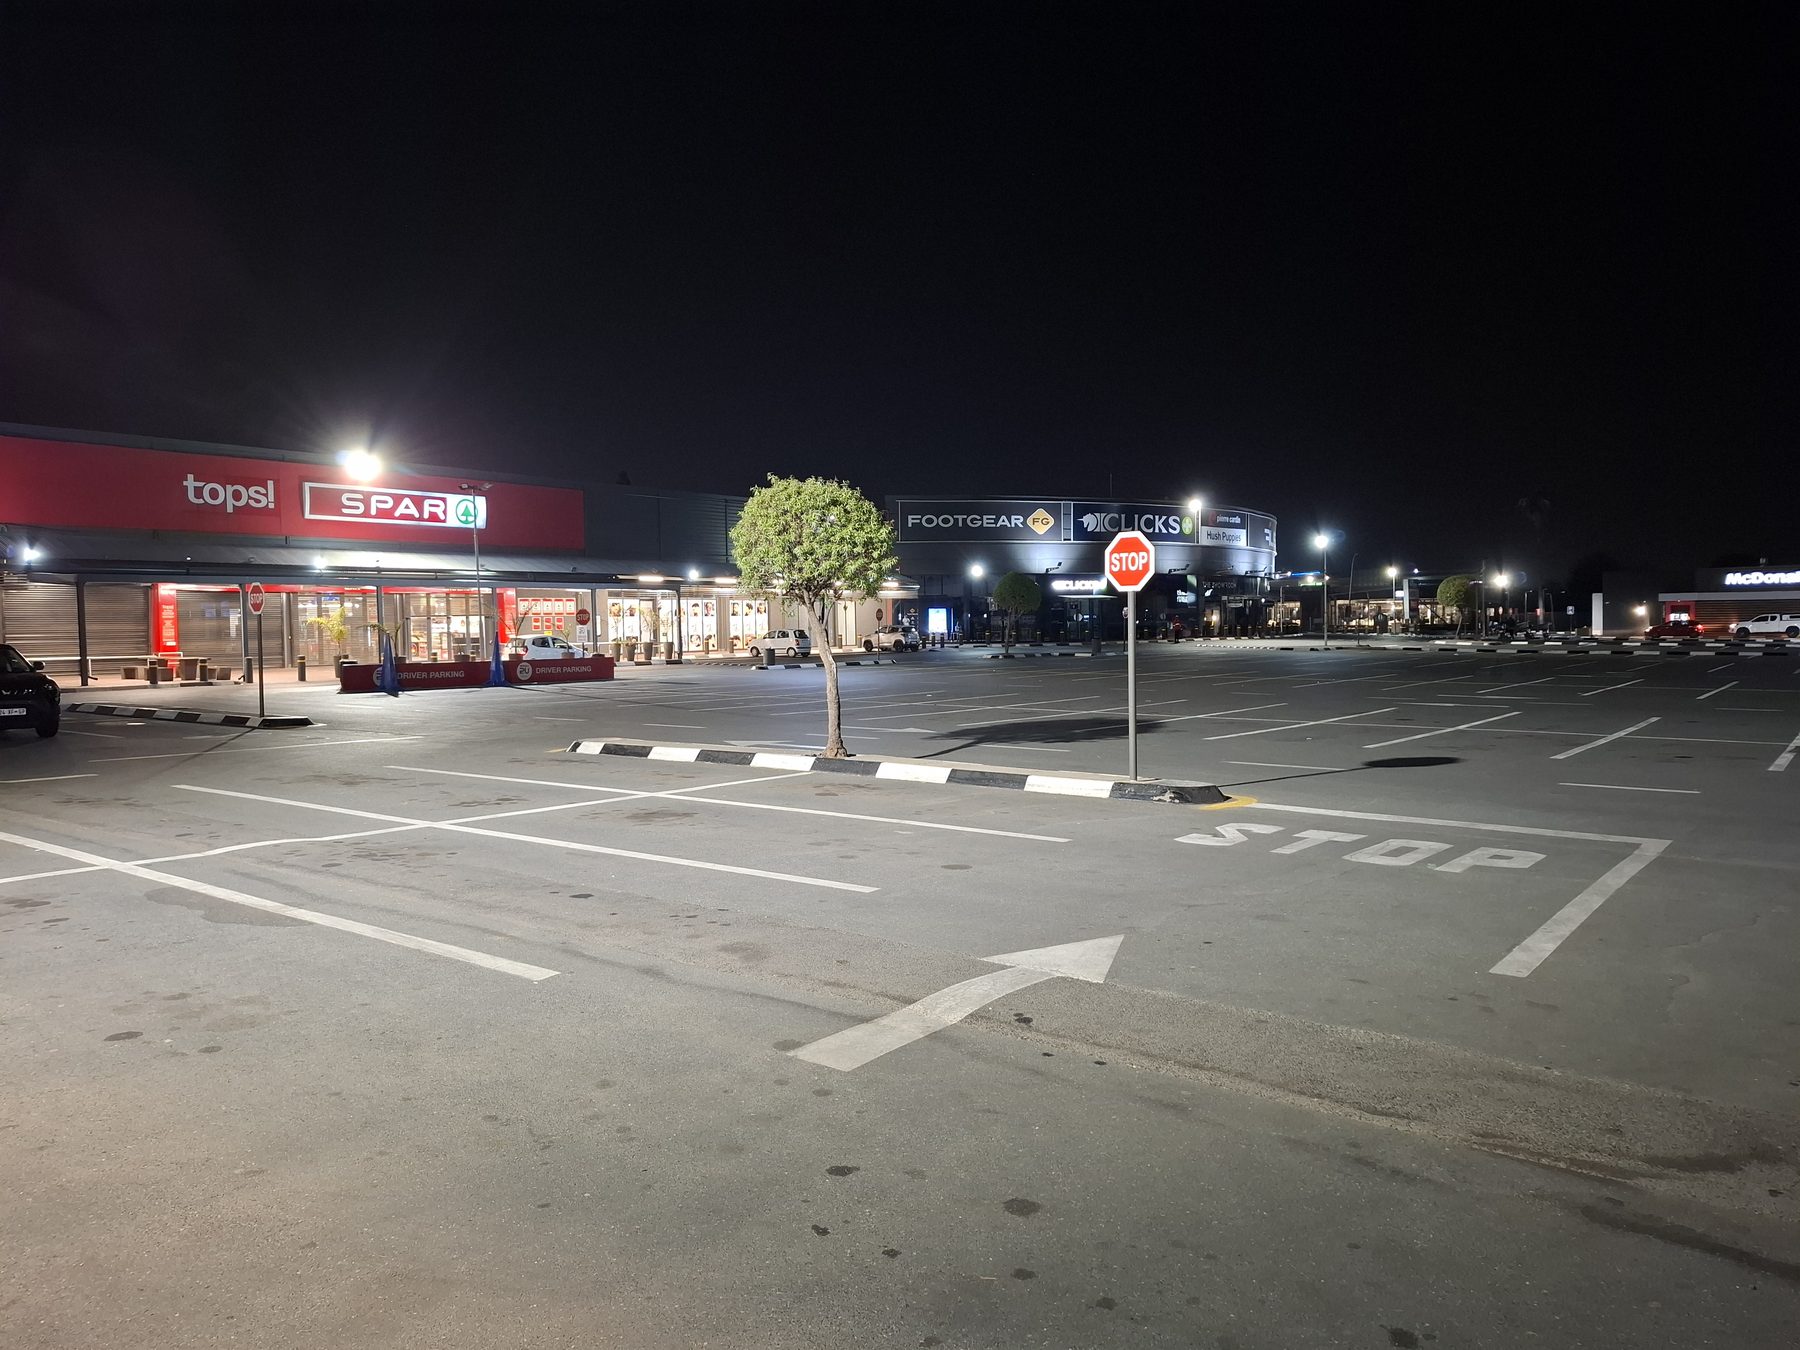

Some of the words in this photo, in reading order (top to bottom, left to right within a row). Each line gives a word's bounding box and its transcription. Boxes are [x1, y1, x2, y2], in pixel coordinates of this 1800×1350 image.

[183, 474, 274, 512] tops!
[341, 493, 446, 520] SPAR
[908, 514, 1024, 528] FOOTGEAR
[1032, 517, 1050, 527] FG
[1104, 512, 1181, 535] CLICKS
[1207, 530, 1222, 541] Hush
[1110, 552, 1149, 572] STOP
[250, 593, 263, 604] STOP
[397, 671, 428, 680] DRIVER
[429, 670, 465, 679] PARKING
[536, 667, 561, 675] DRIVER
[562, 665, 591, 673] PARKING
[1174, 822, 1548, 873] STOP
